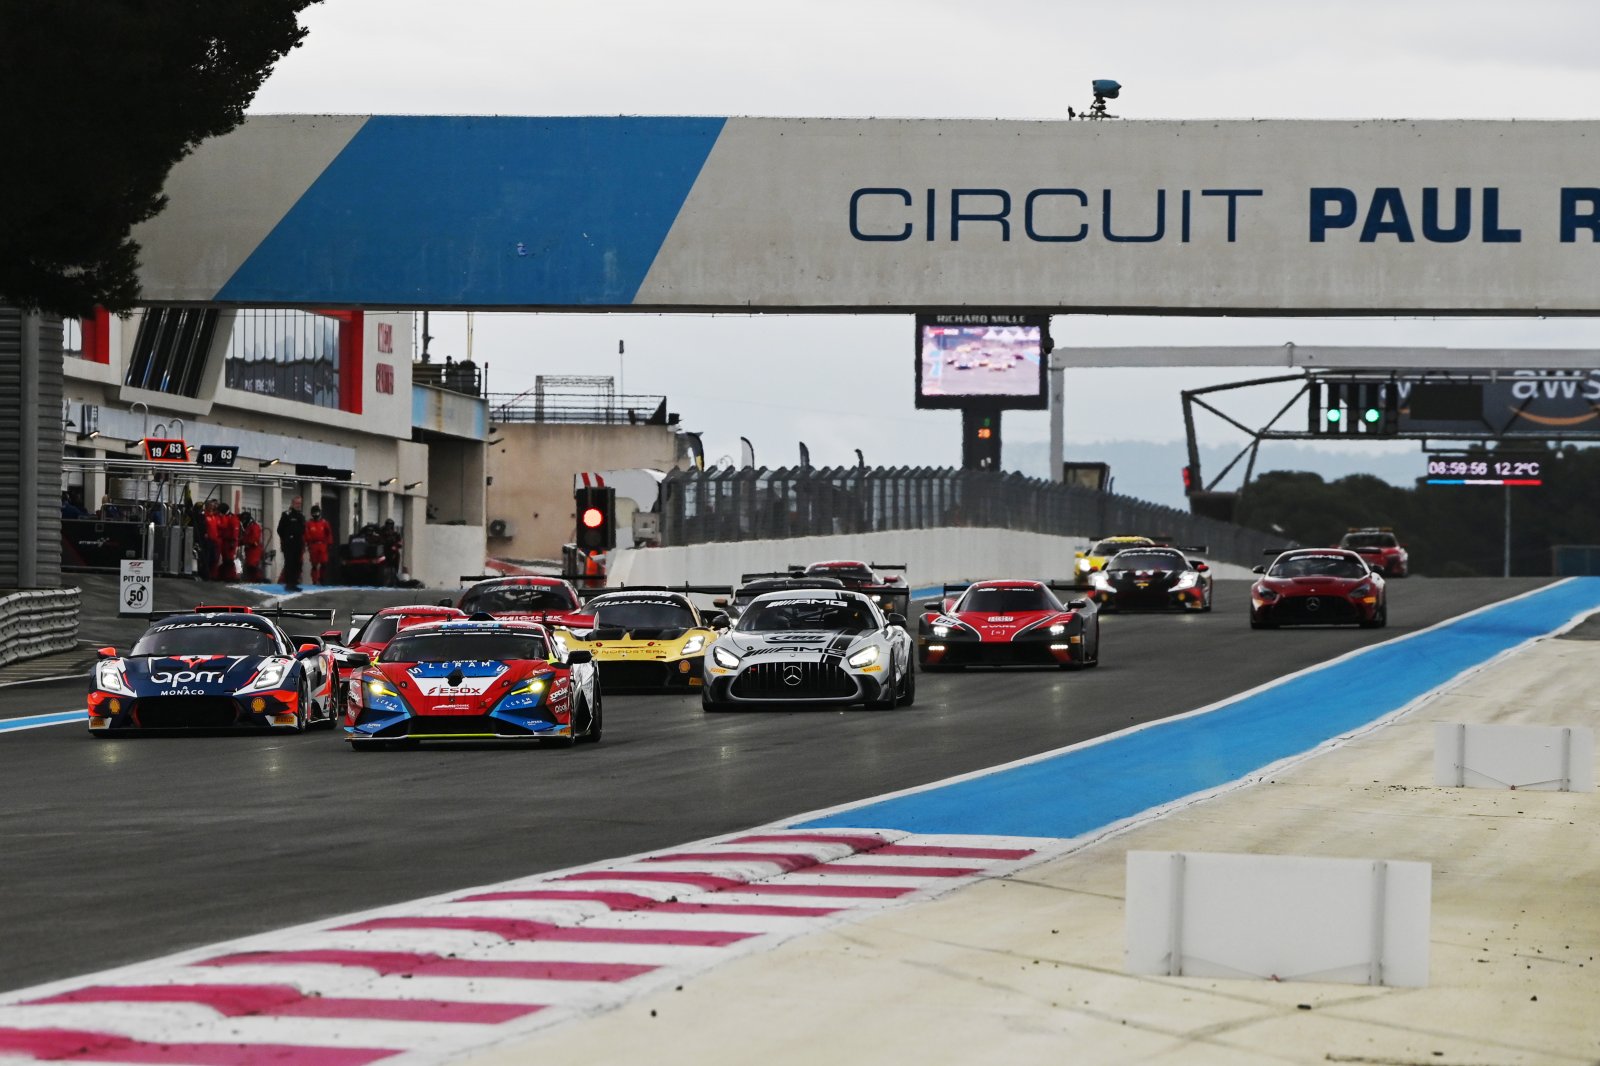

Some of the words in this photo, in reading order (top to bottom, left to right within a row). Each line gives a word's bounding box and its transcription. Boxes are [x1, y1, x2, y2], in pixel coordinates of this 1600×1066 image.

[849, 188, 1263, 242] CIRCUIT
[1308, 187, 1521, 243] PAUL
[1560, 187, 1600, 243] R
[936, 314, 988, 324] RICHARD
[1512, 370, 1600, 399] aws
[151, 447, 162, 457] 19
[169, 443, 182, 453] 63
[203, 453, 213, 463] 19
[221, 449, 233, 459] 63
[130, 590, 144, 602] 50
[593, 600, 681, 608] Maserati
[796, 599, 848, 608] AMG
[154, 622, 260, 633] Maserati
[150, 670, 225, 688] apm
